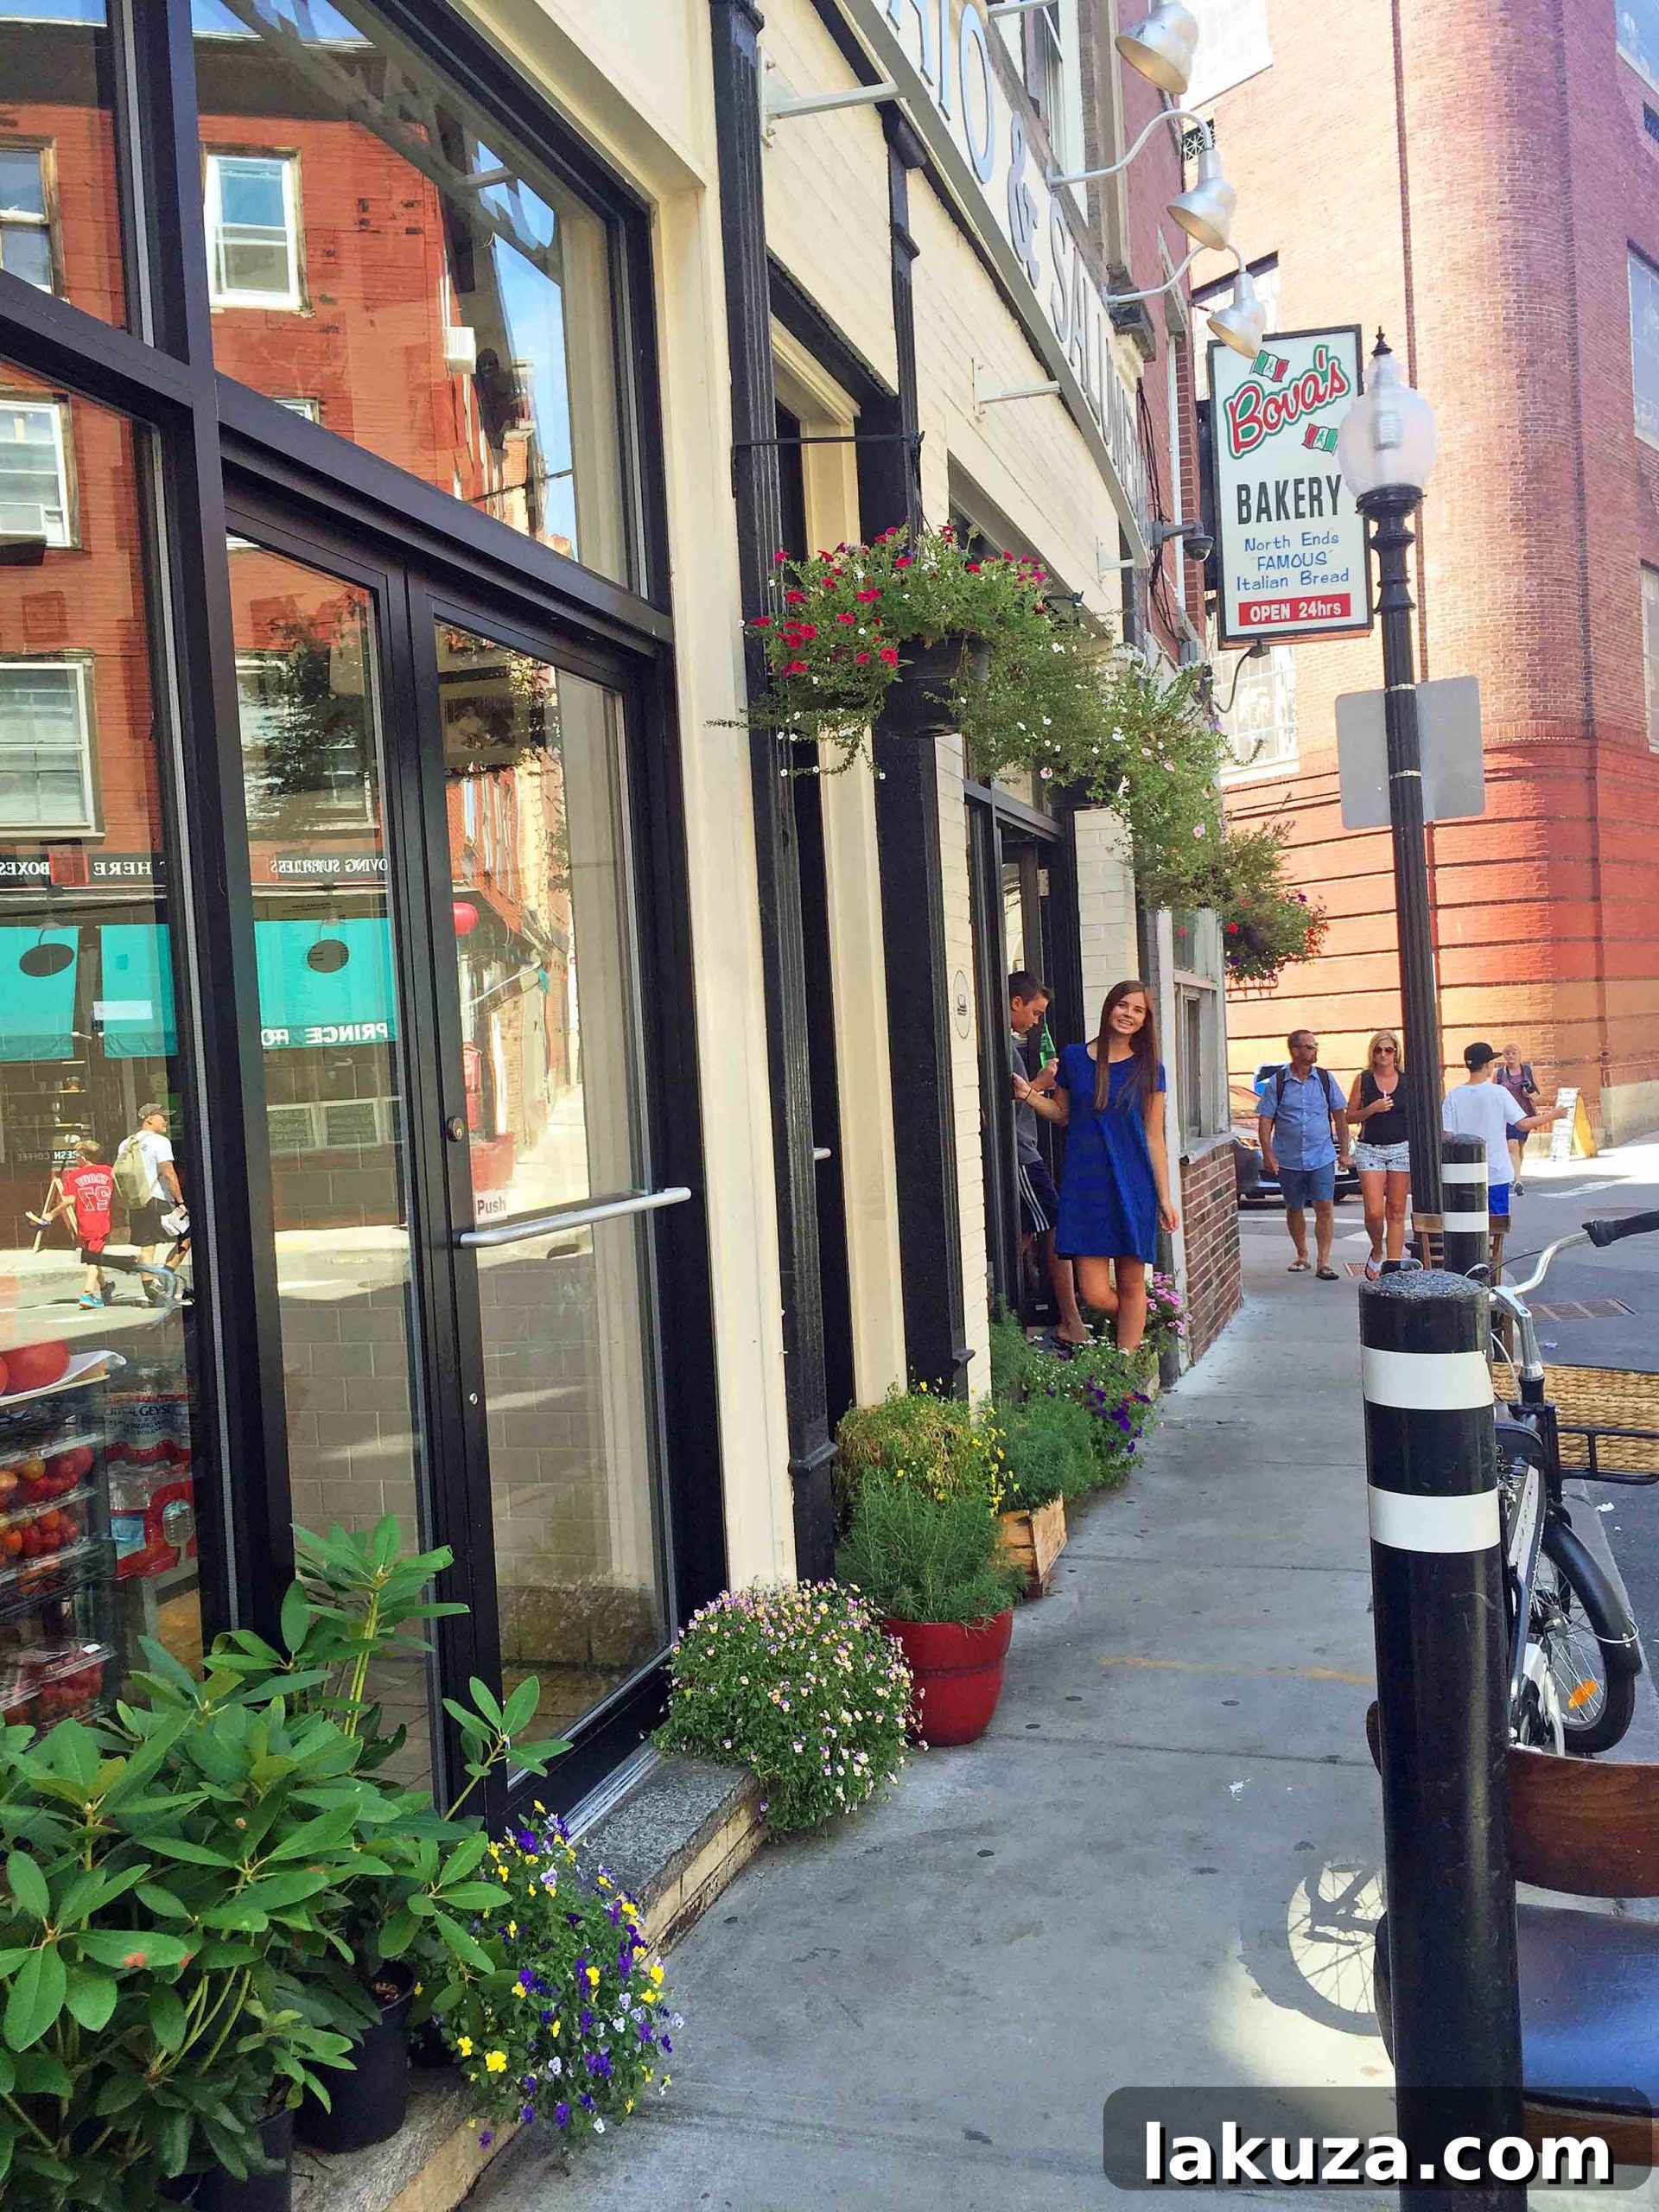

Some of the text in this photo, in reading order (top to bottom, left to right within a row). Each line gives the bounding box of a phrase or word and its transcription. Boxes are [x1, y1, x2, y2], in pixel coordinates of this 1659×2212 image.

[1224, 346, 1350, 458] Bova's
[1237, 474, 1342, 524] BAKERY
[1244, 531, 1339, 551] North Ends
[1237, 568, 1349, 591] Italian Bread
[1249, 601, 1342, 623] OPEN 24hrs
[477, 1198, 506, 1215] Push
